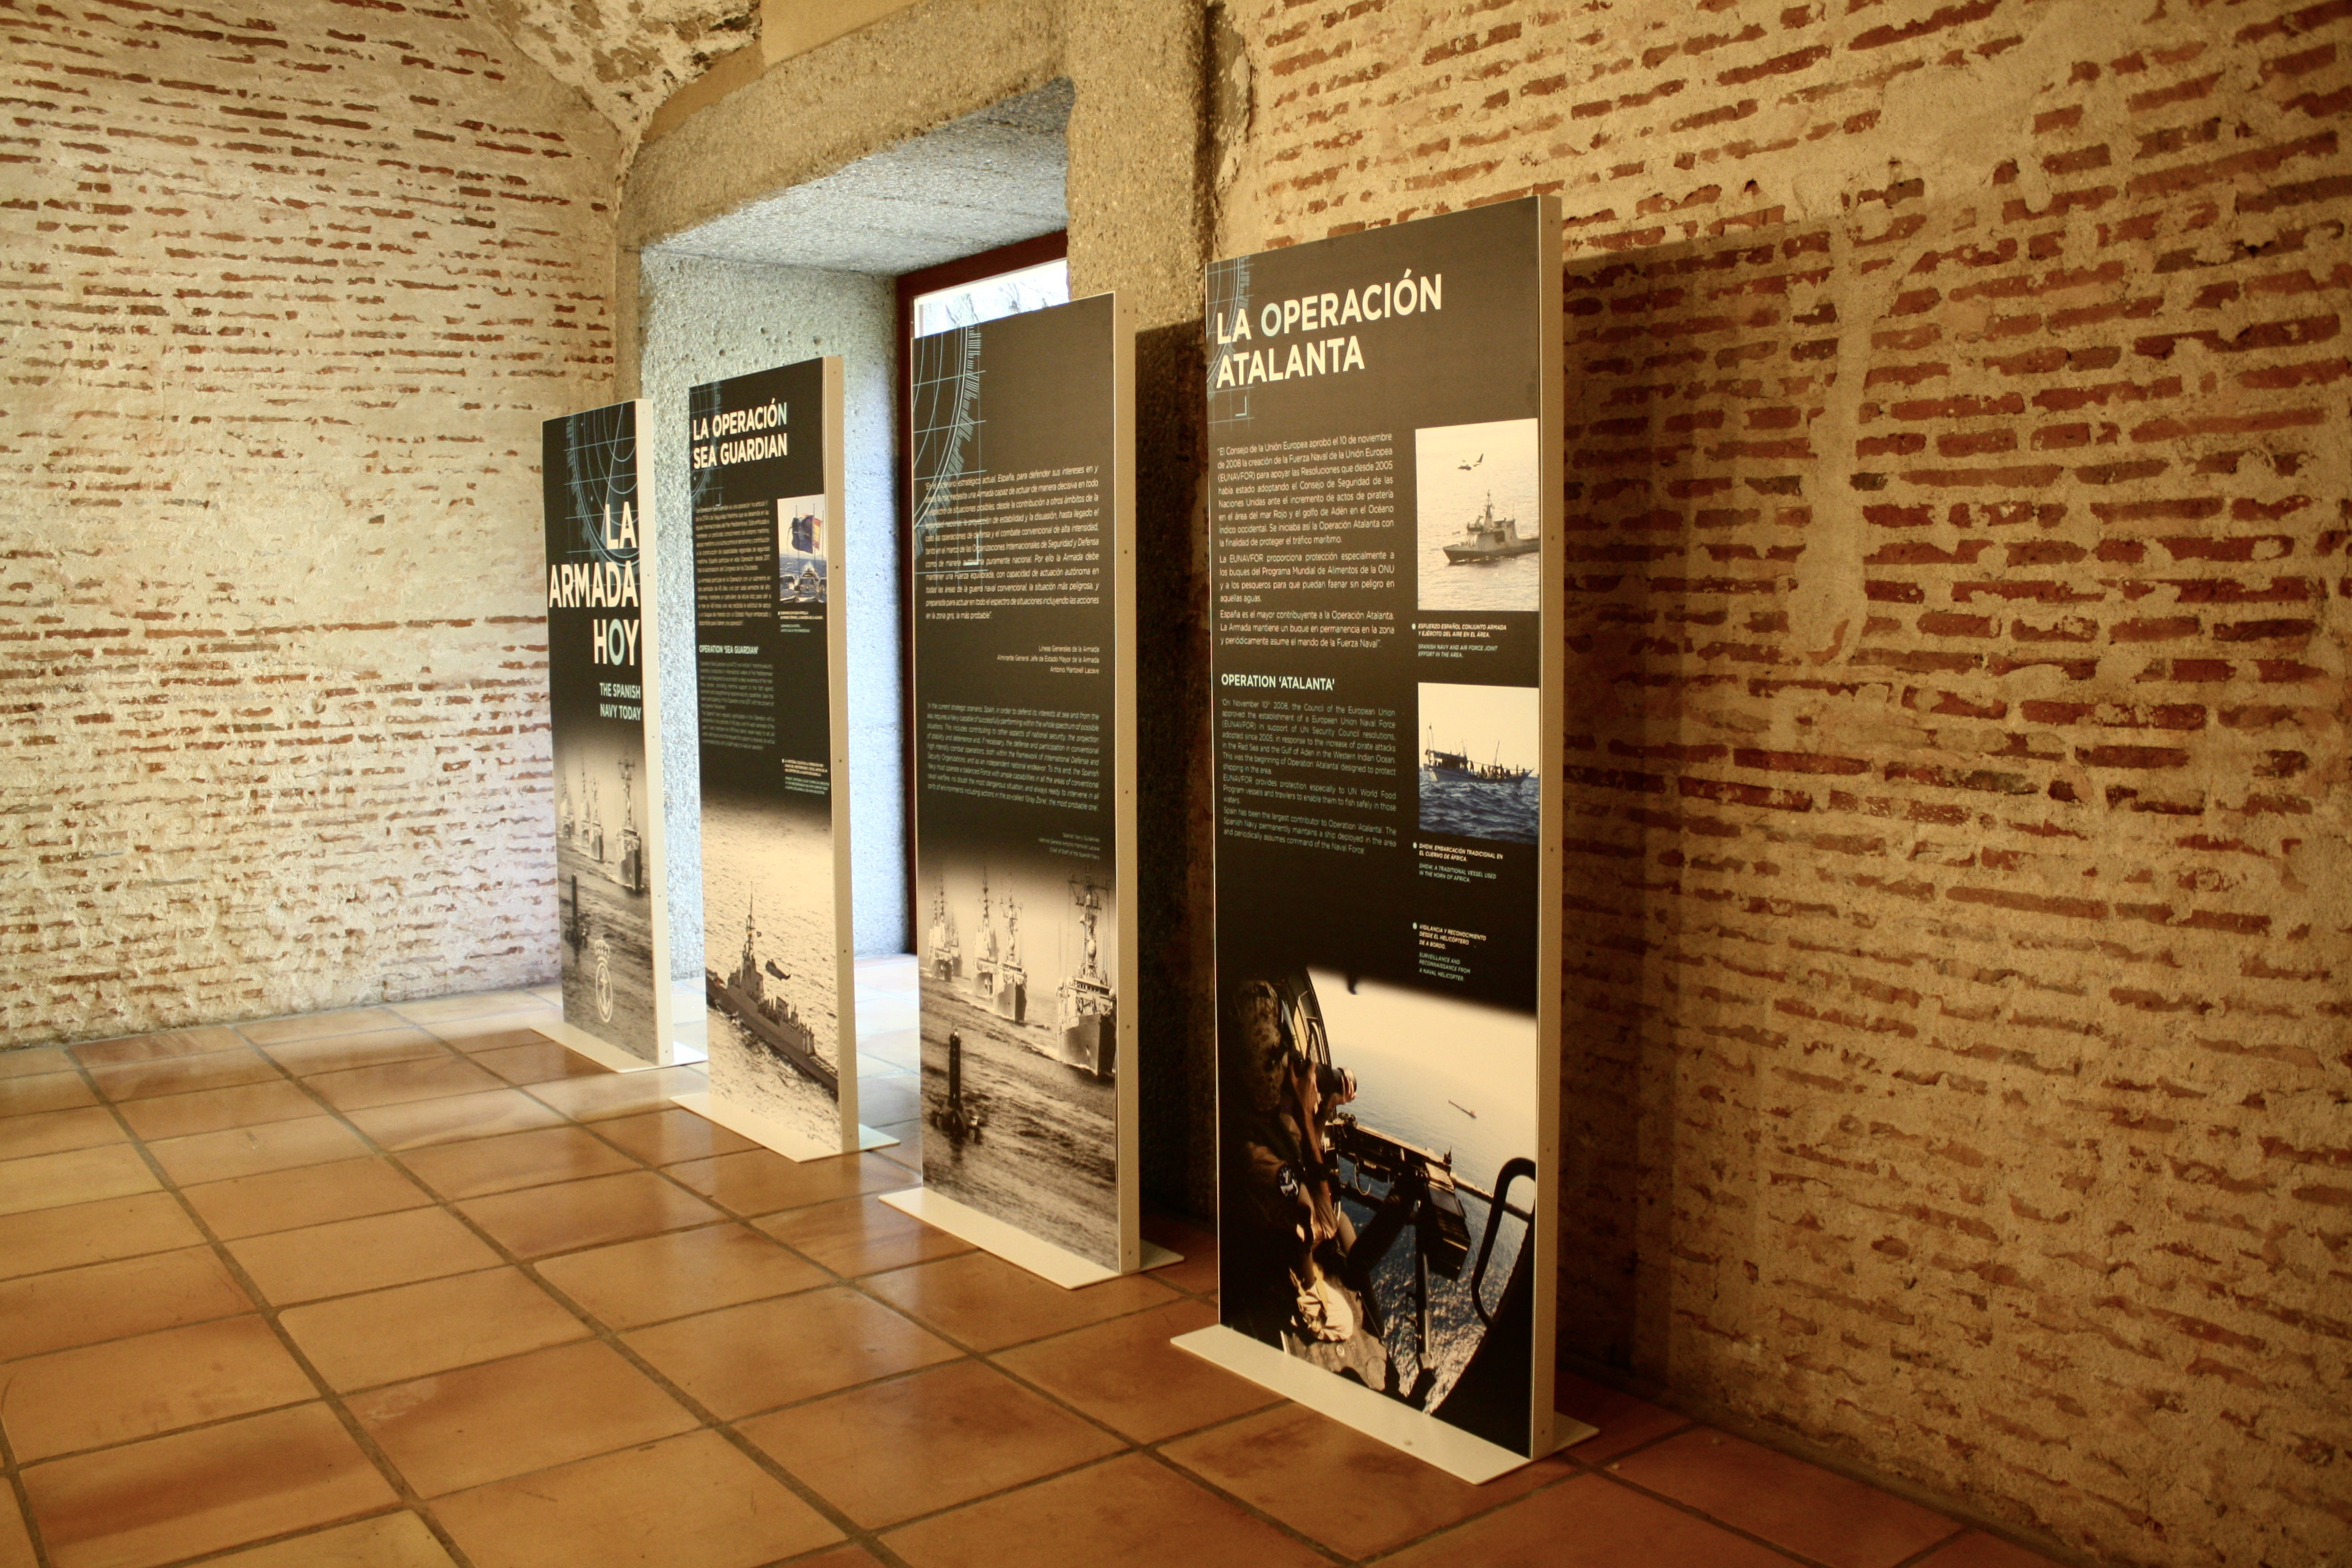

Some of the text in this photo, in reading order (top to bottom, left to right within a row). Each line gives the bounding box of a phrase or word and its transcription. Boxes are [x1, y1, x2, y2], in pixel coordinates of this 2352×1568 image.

[1218, 268, 1442, 344] LA OPERACIÓN
[1216, 336, 1365, 388] ATALANTA
[694, 397, 786, 440] LA OPERACIÓN
[694, 433, 787, 469] SEA GUARDIAN
[1226, 446, 1248, 455] Consejo
[1283, 442, 1307, 451] Europea
[1310, 438, 1331, 449] aprobó
[1358, 434, 1392, 443] noviembre
[1226, 459, 1241, 468] 2008
[1249, 457, 1272, 466] creación
[1311, 452, 1327, 461] Naval
[1366, 449, 1392, 457] Europea
[1271, 471, 1290, 479] apoyar
[1301, 466, 1340, 475] Resoluciones
[1355, 463, 1374, 471] desde
[1376, 462, 1393, 470] 2005
[1219, 486, 1233, 495] había
[1236, 485, 1255, 493] estado
[1258, 483, 1290, 493] adoptando
[1299, 481, 1324, 490] Consejo
[1337, 477, 1370, 488] Seguridad
[1290, 495, 1324, 503] incremento
[1367, 490, 1393, 501] piratería
[1273, 510, 1287, 519] Rojo
[1303, 509, 1318, 518] golfo
[605, 501, 637, 550] LA
[1219, 524, 1236, 533] Índico
[1319, 520, 1351, 531] Operación
[1353, 519, 1380, 528] Atalanta
[1260, 537, 1284, 547] proteger
[1267, 553, 1302, 563] proporciona
[1304, 553, 1340, 562] protección
[1341, 551, 1388, 561] especialmente
[1230, 568, 1249, 577] buques
[1262, 568, 1290, 576] Programa
[549, 560, 638, 608] ARMADA
[1302, 580, 1326, 590] puedan
[1361, 580, 1384, 589] peligro
[1220, 594, 1242, 603] aquellas
[593, 619, 639, 666] HOY
[1222, 673, 1276, 687] OPERATION
[600, 683, 641, 699] THE SPANISH
[600, 703, 641, 720] NAVY TODAY
